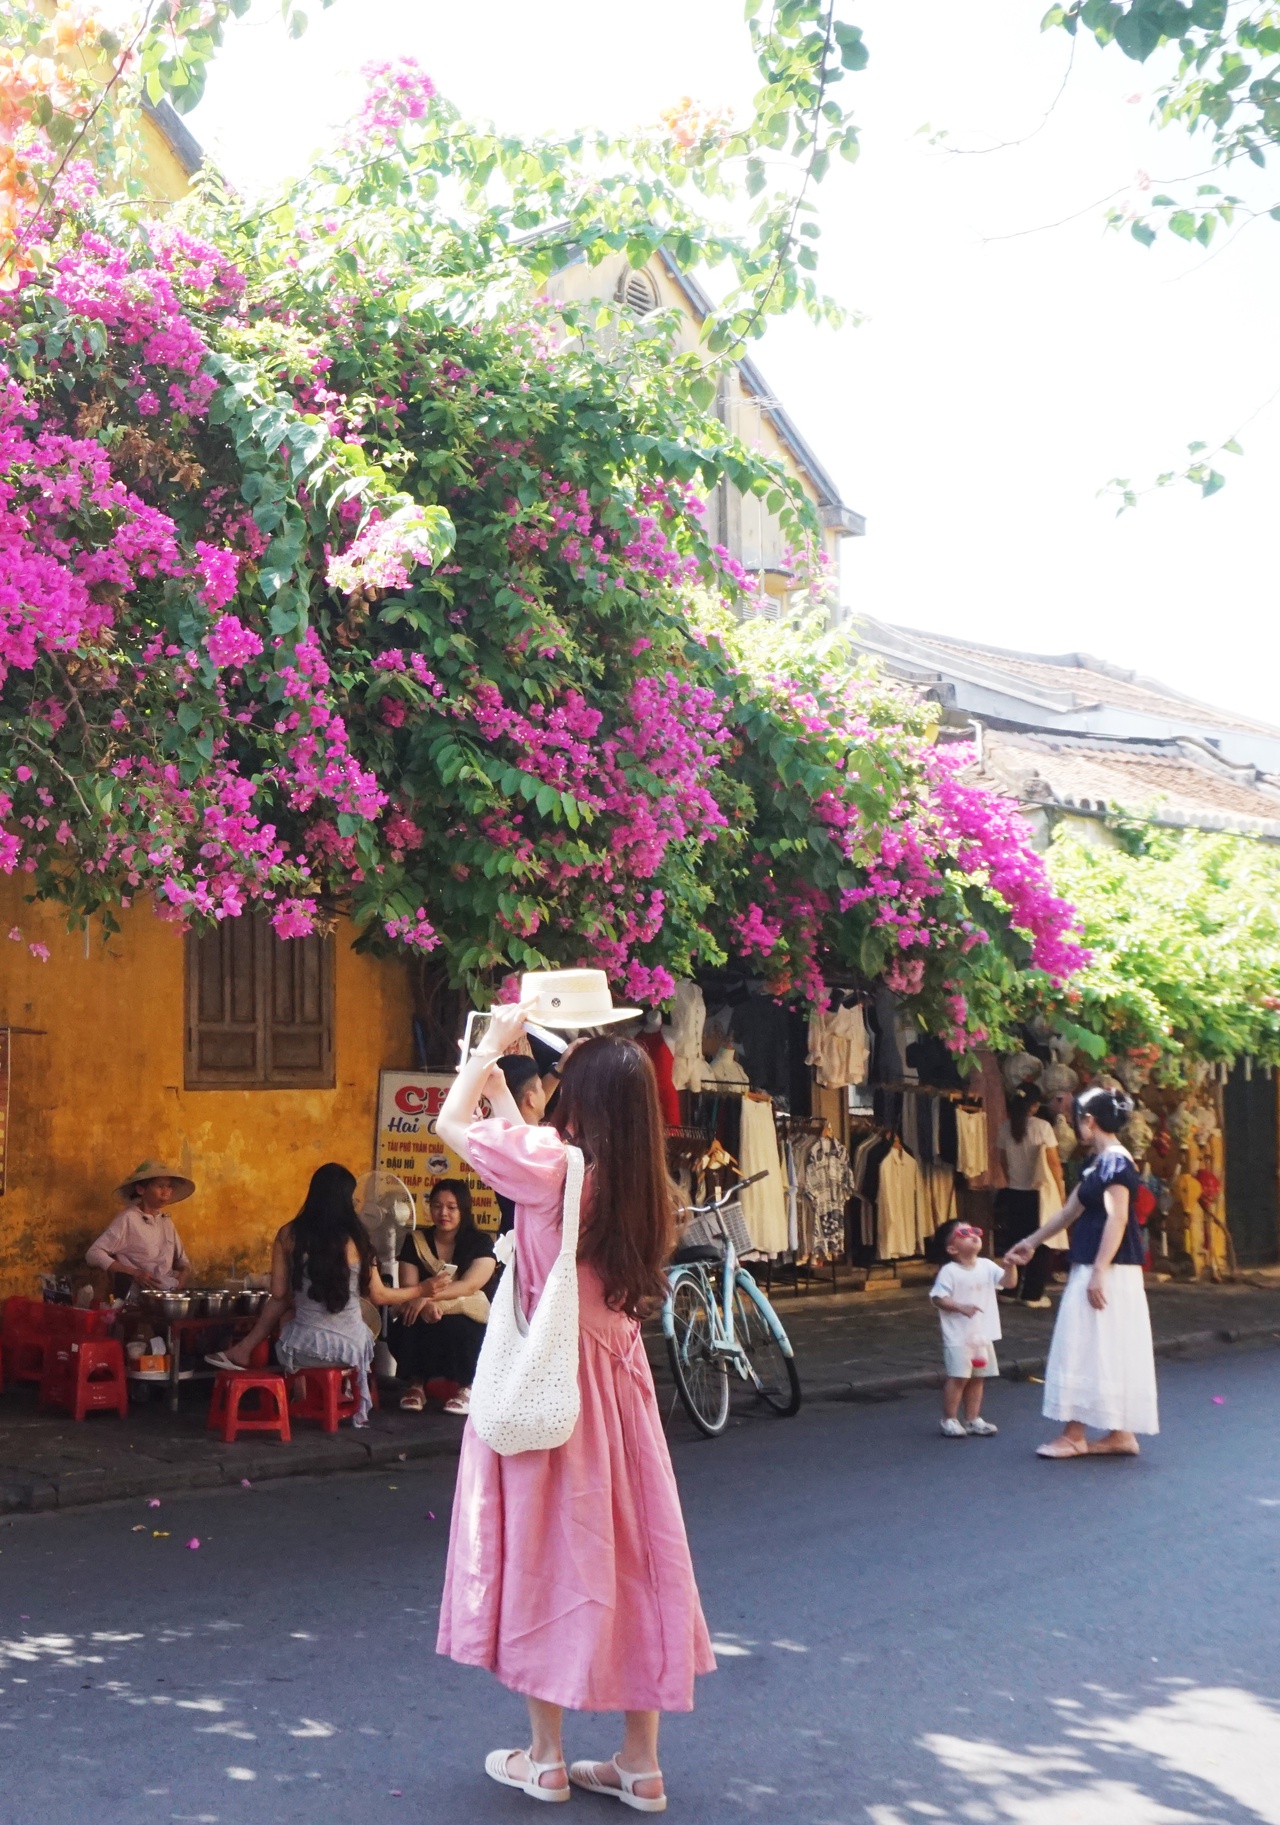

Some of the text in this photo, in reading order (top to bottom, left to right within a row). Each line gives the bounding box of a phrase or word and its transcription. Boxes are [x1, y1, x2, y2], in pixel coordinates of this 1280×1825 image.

[388, 1117, 419, 1133] Hai
[387, 1156, 402, 1170] ĐẬU
[403, 1174, 422, 1188] THẬP
